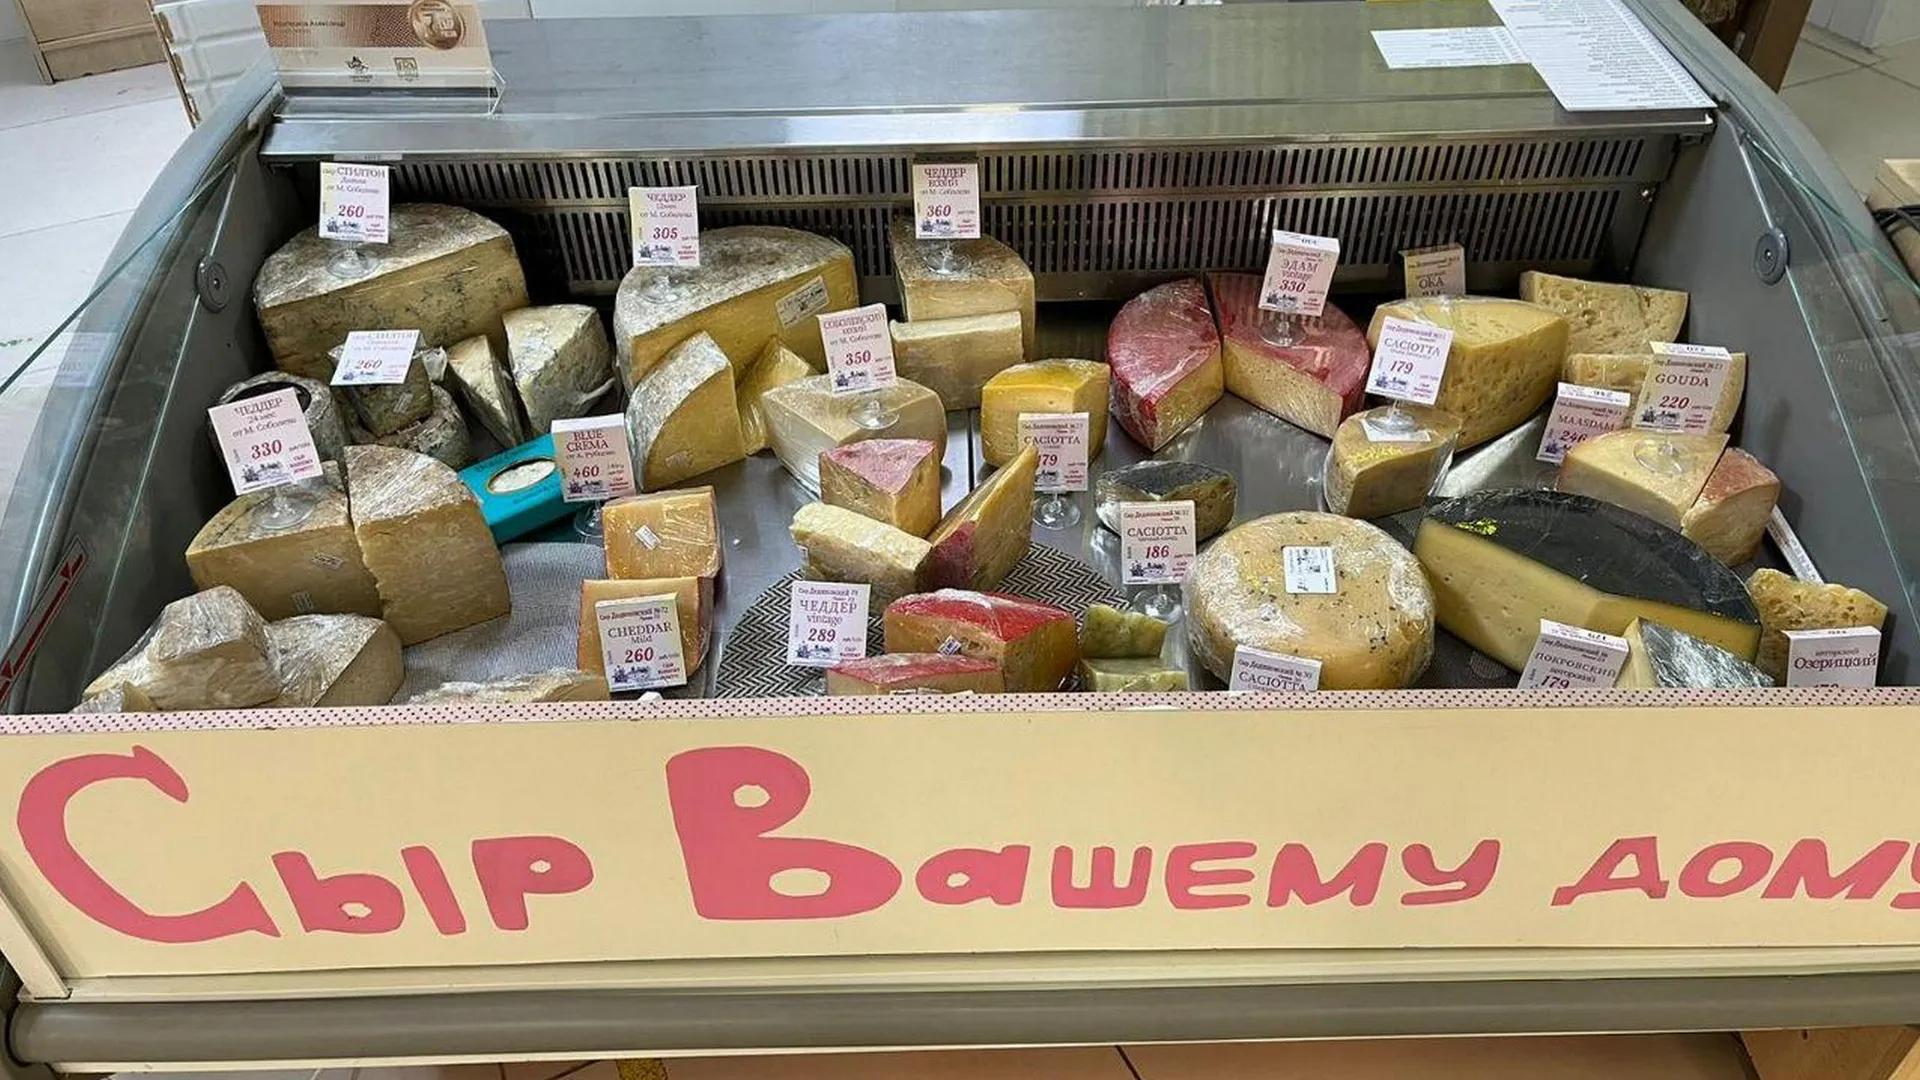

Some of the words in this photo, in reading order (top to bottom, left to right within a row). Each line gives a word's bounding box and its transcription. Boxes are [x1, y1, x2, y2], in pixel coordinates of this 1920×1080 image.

[924, 168, 967, 179] ЧЕДДЕР
[338, 204, 364, 218] 260
[927, 204, 952, 218] 360
[653, 227, 678, 240] 305
[1281, 259, 1318, 273] ЭДАМ
[1279, 279, 1306, 293] 330
[1384, 337, 1441, 357] CACIOTTA
[355, 359, 383, 370] 260
[845, 350, 871, 366] 350
[1390, 360, 1414, 375] 179
[1655, 373, 1709, 388] GOUDA
[234, 397, 283, 417] ЧЕДДЕР
[1659, 395, 1690, 410] 220
[1559, 414, 1615, 431] MAASDAM
[573, 429, 605, 441] BLUE
[1024, 435, 1080, 445] CACIOTTA
[251, 439, 282, 460] 330
[566, 439, 609, 453] CREMA
[573, 465, 600, 478] 460
[1127, 525, 1189, 538] CACIOTTA
[1145, 545, 1170, 559] 186
[800, 599, 858, 615] ЧЕДДЕР
[807, 613, 843, 628] vintage
[608, 621, 673, 639] CHEDDAR
[808, 627, 837, 642] 289
[625, 647, 654, 663] 260
[1238, 671, 1307, 692] CACIOTTA
[1541, 676, 1570, 690] 179
